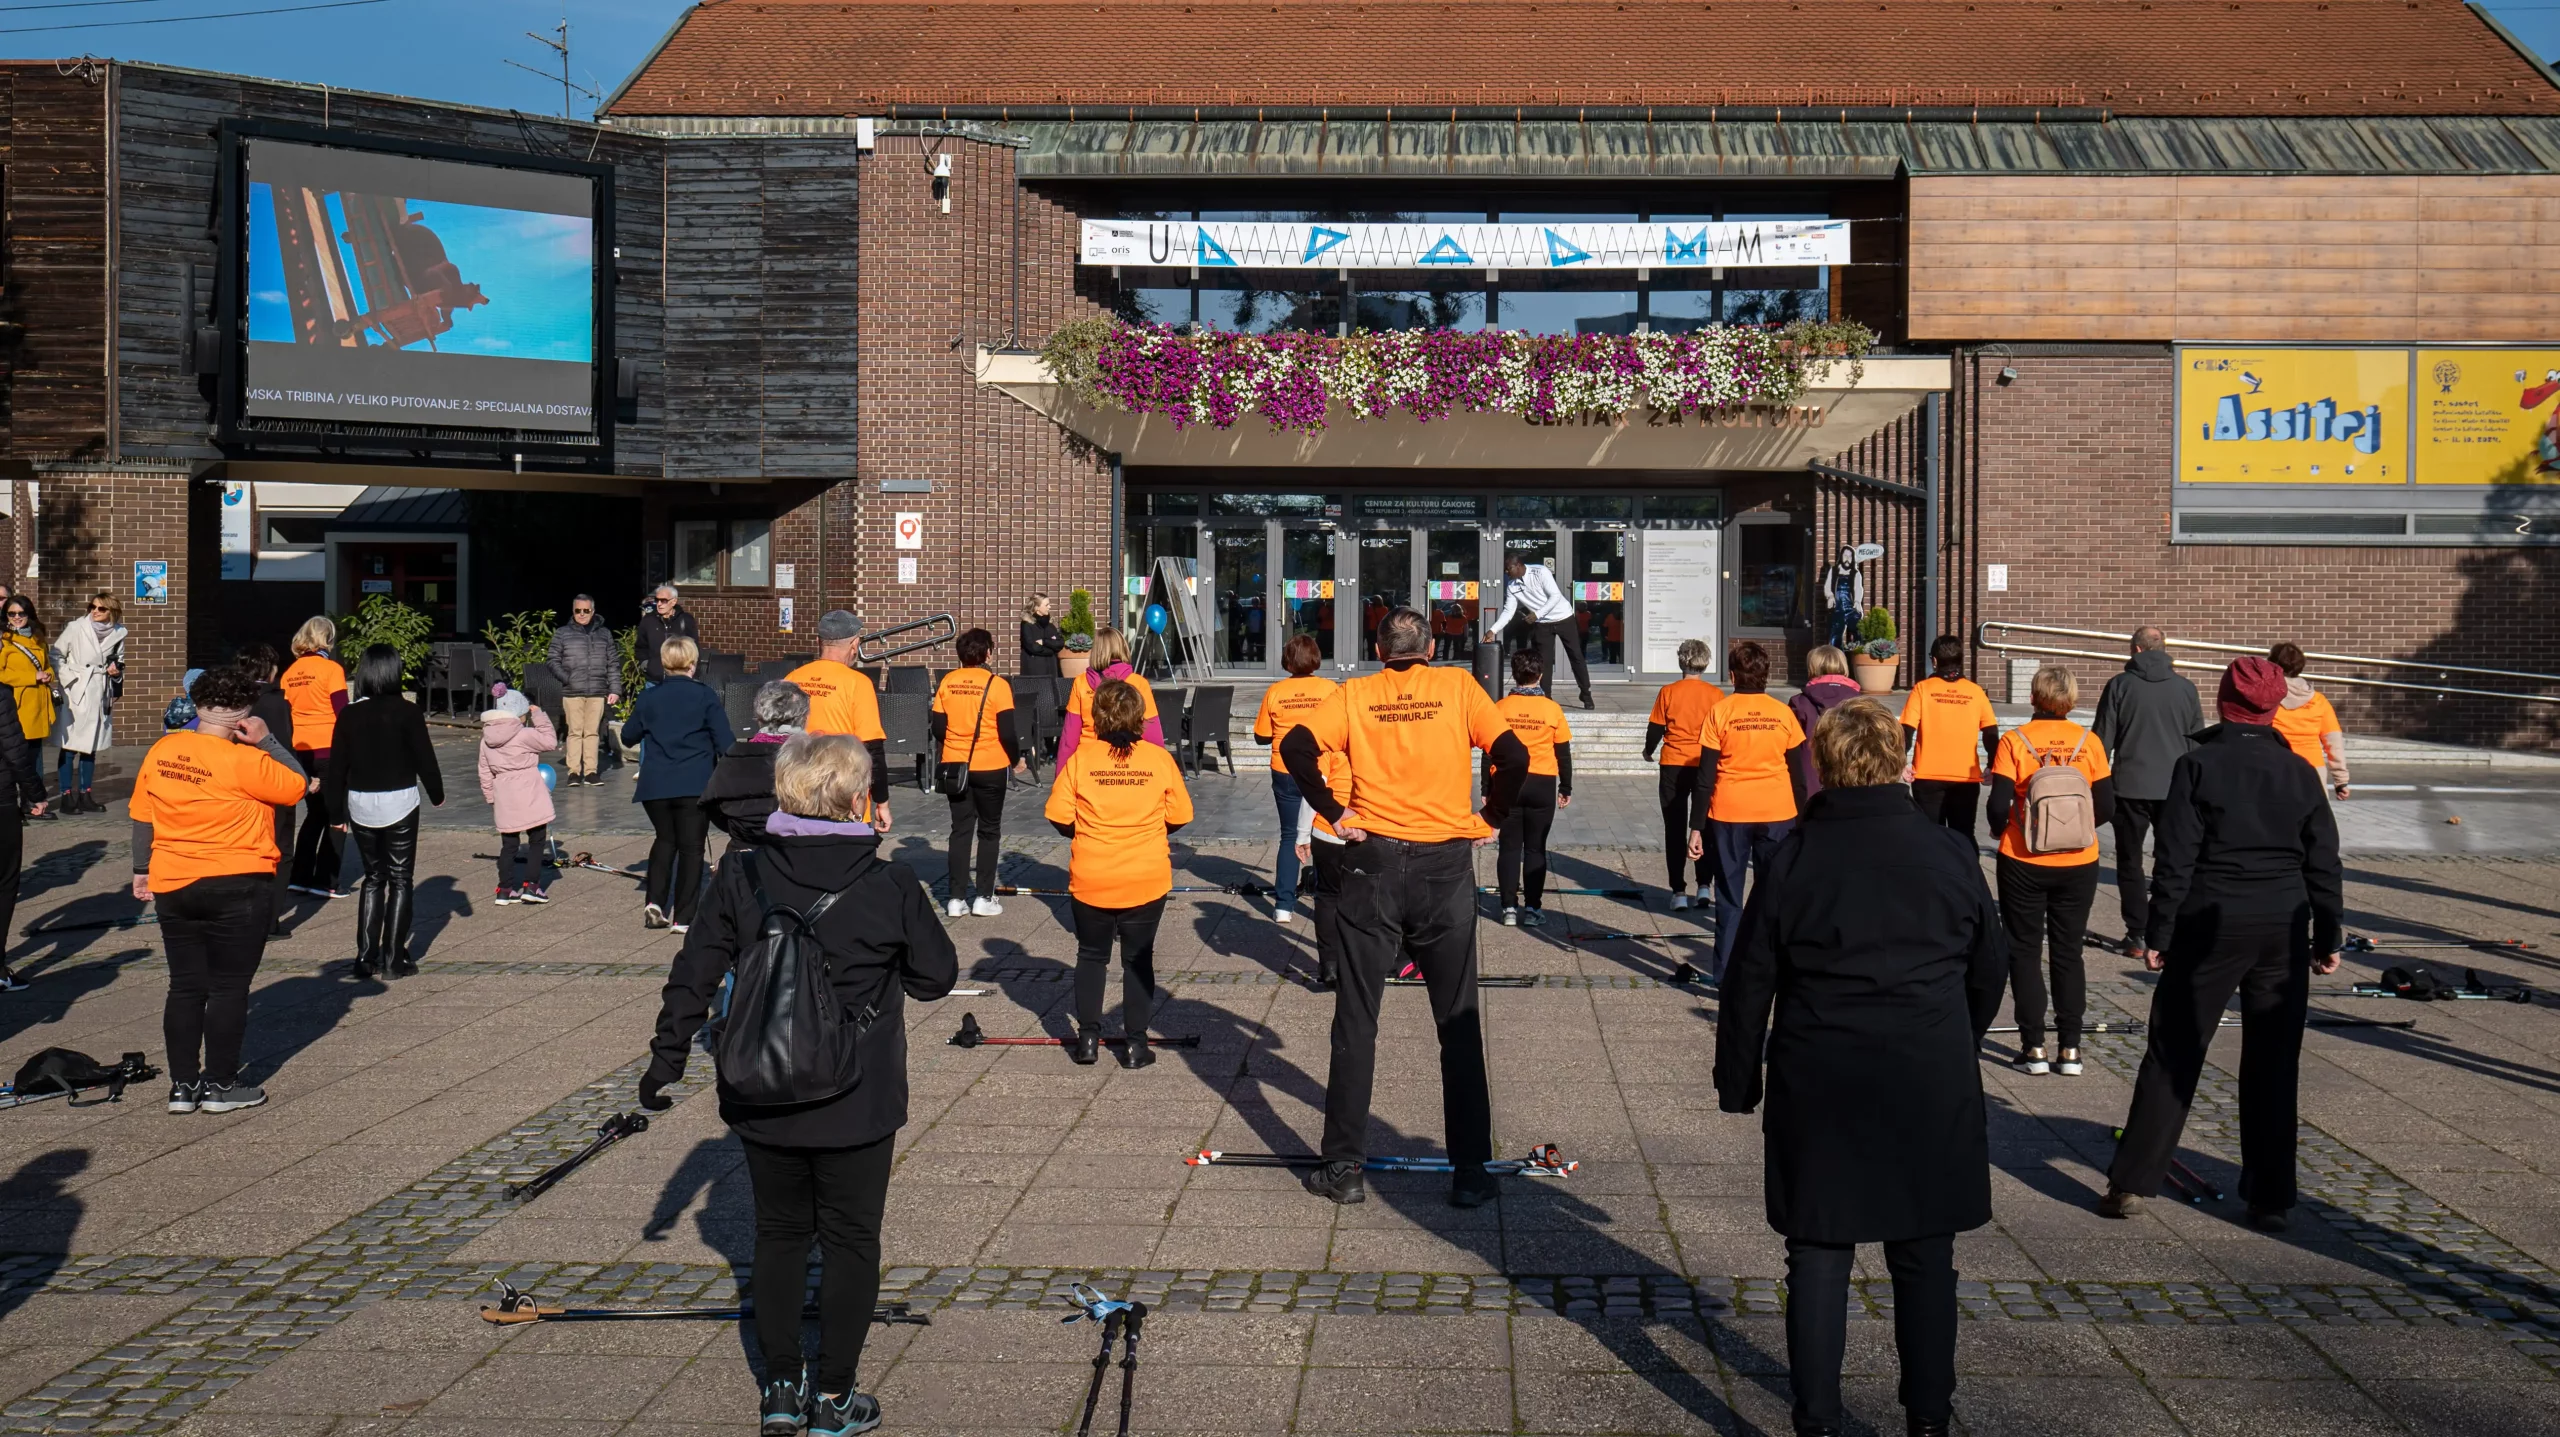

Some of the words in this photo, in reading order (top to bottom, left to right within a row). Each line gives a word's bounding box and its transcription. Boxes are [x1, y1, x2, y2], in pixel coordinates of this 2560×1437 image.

[1111, 245, 1130, 254] oris
[286, 390, 334, 404] TRIBINA
[346, 393, 388, 407] VELIKO
[391, 396, 460, 411] PUTOVANJE
[463, 400, 473, 411] 2:
[475, 400, 543, 415] SPECIJALNA
[1646, 404, 1685, 428] ZA
[1700, 404, 1825, 428] KULTURU
[2213, 394, 2381, 454] Assitej
[1406, 500, 1439, 508] KULTURU
[1441, 499, 1476, 508] ČAKOVEC
[1410, 701, 1443, 710] HODANJA
[185, 764, 213, 778] HODANJA
